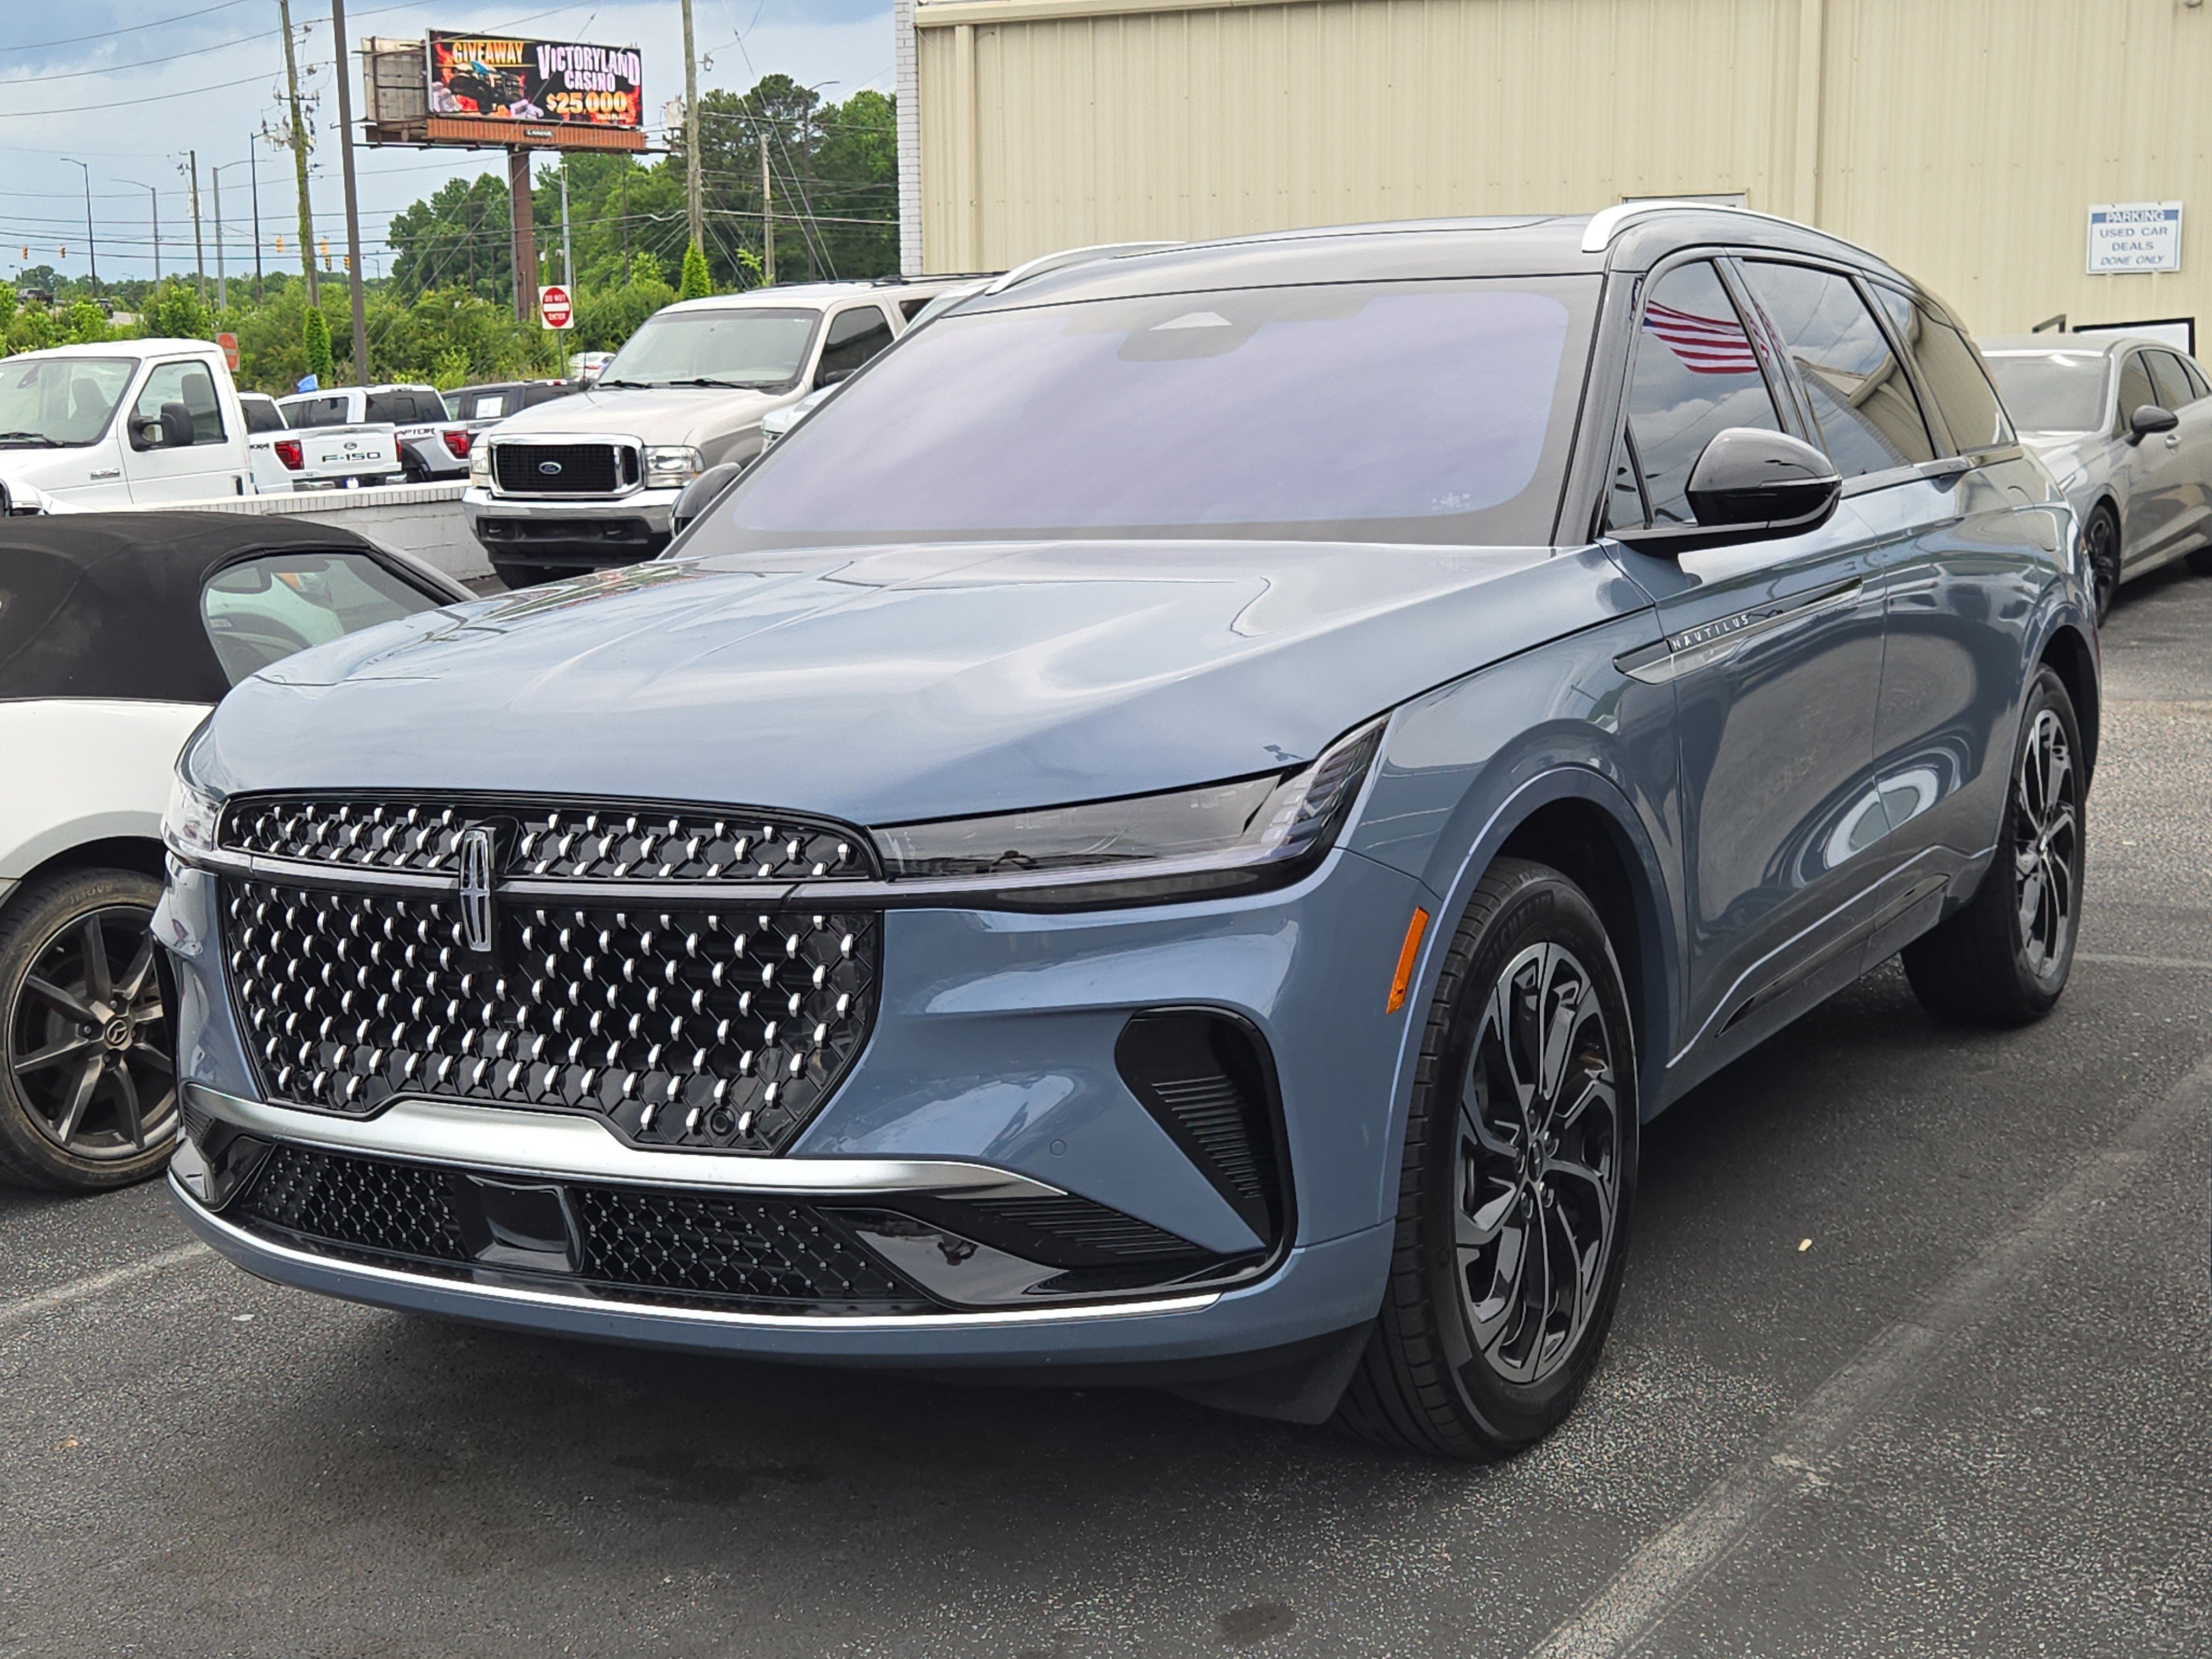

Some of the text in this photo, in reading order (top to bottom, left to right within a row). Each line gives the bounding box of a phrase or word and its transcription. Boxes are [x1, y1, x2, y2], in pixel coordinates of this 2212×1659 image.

[453, 42, 524, 63] GIVEAWAY
[536, 44, 640, 87] VICTORYLAND
[564, 69, 616, 92] CASINO
[546, 91, 627, 115] $25,000
[2106, 210, 2165, 223] PARKING
[2100, 227, 2168, 238] USED CAR
[2112, 241, 2154, 251] DEALS
[2100, 254, 2165, 266] DONE ONLY
[322, 452, 381, 462] F-150
[1673, 615, 1750, 651] NAUTILUS
